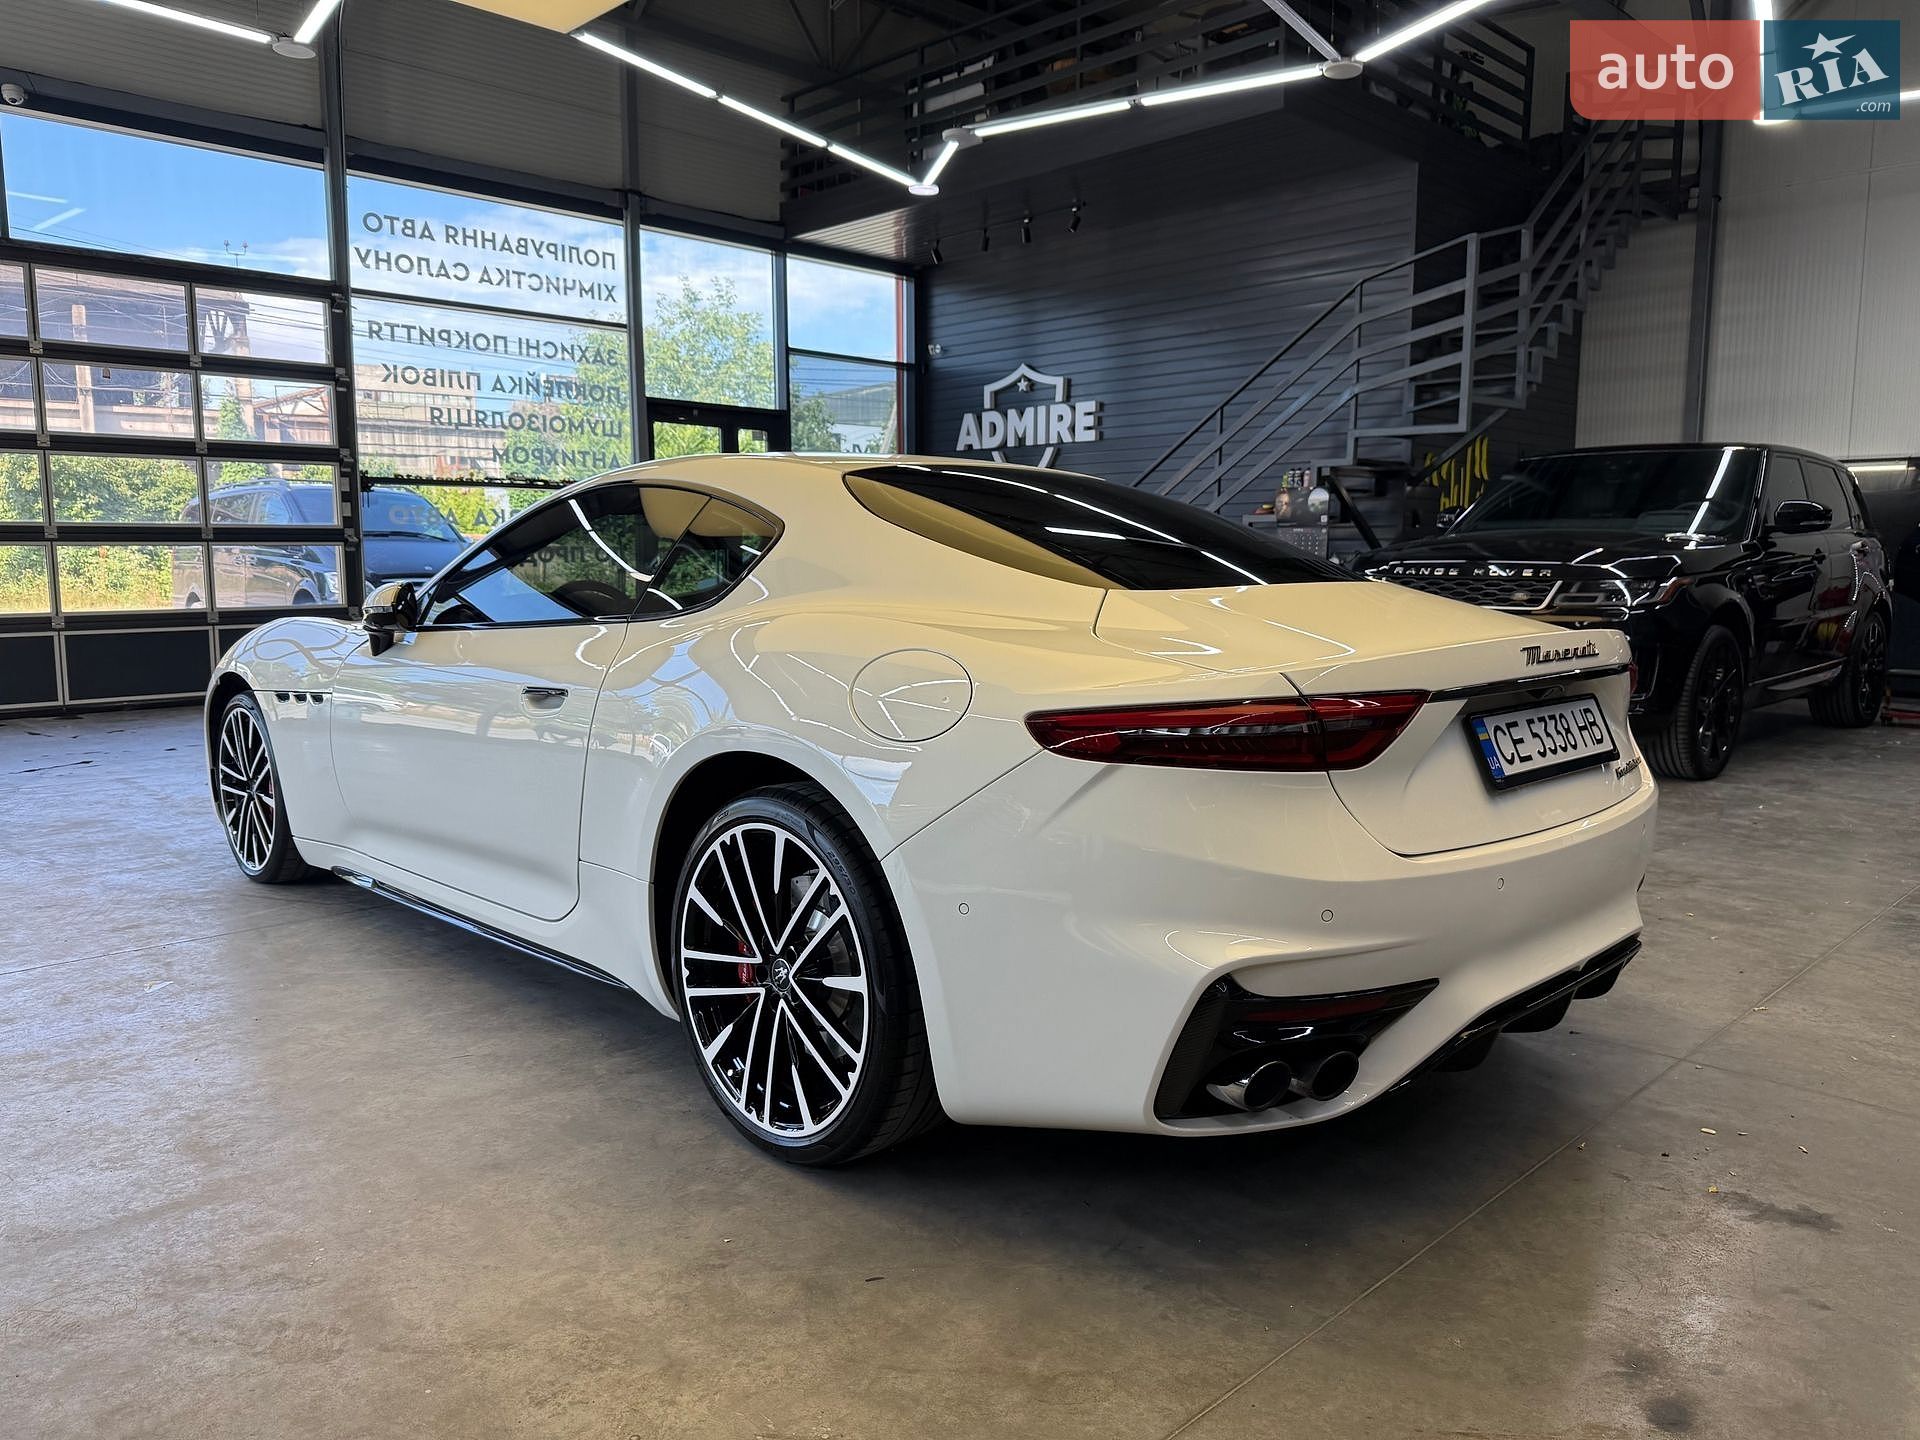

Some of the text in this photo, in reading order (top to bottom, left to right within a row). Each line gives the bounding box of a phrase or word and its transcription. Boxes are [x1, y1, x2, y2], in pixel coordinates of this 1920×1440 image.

[956, 400, 1098, 451] ADMIRE
[1393, 565, 1552, 577] RANGE ROVER
[1493, 707, 1604, 765] CE 5338 HB
[1487, 755, 1501, 770] UA
